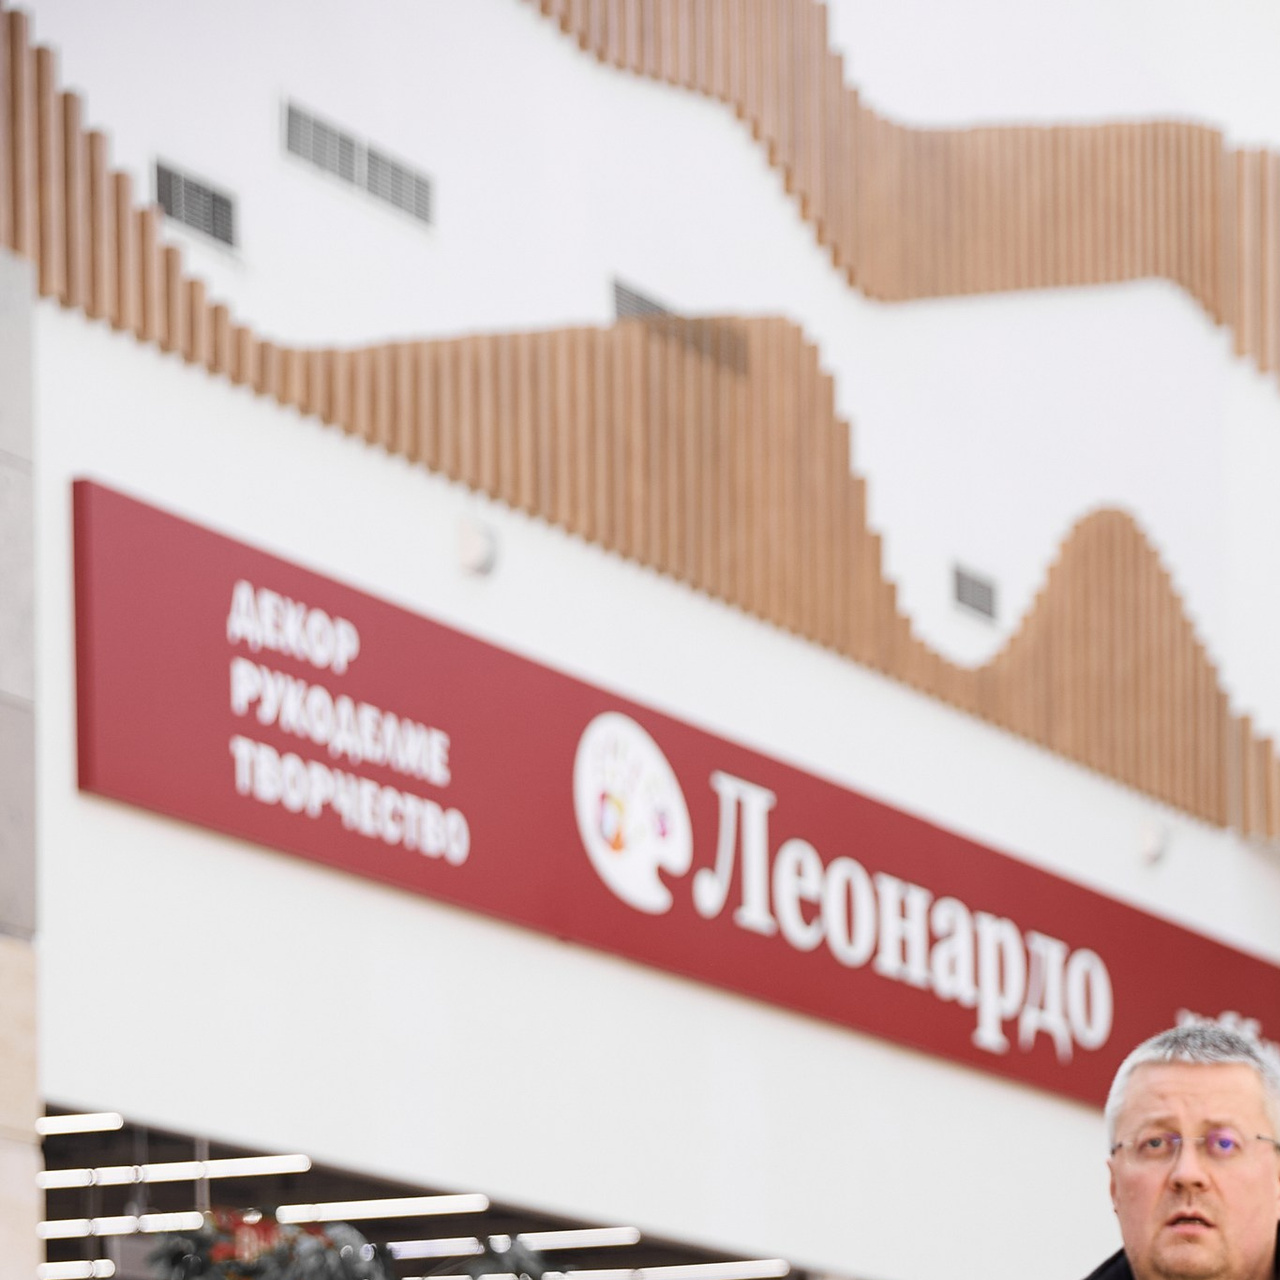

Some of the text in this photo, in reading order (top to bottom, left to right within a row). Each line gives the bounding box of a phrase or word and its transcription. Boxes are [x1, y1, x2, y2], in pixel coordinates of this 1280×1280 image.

[227, 579, 360, 675] ДЕКОР
[229, 656, 451, 787] РУКОДЕЛИЕ
[229, 735, 470, 867] ТВОРЧЕСТВО
[692, 769, 1114, 1065] Леонардо
